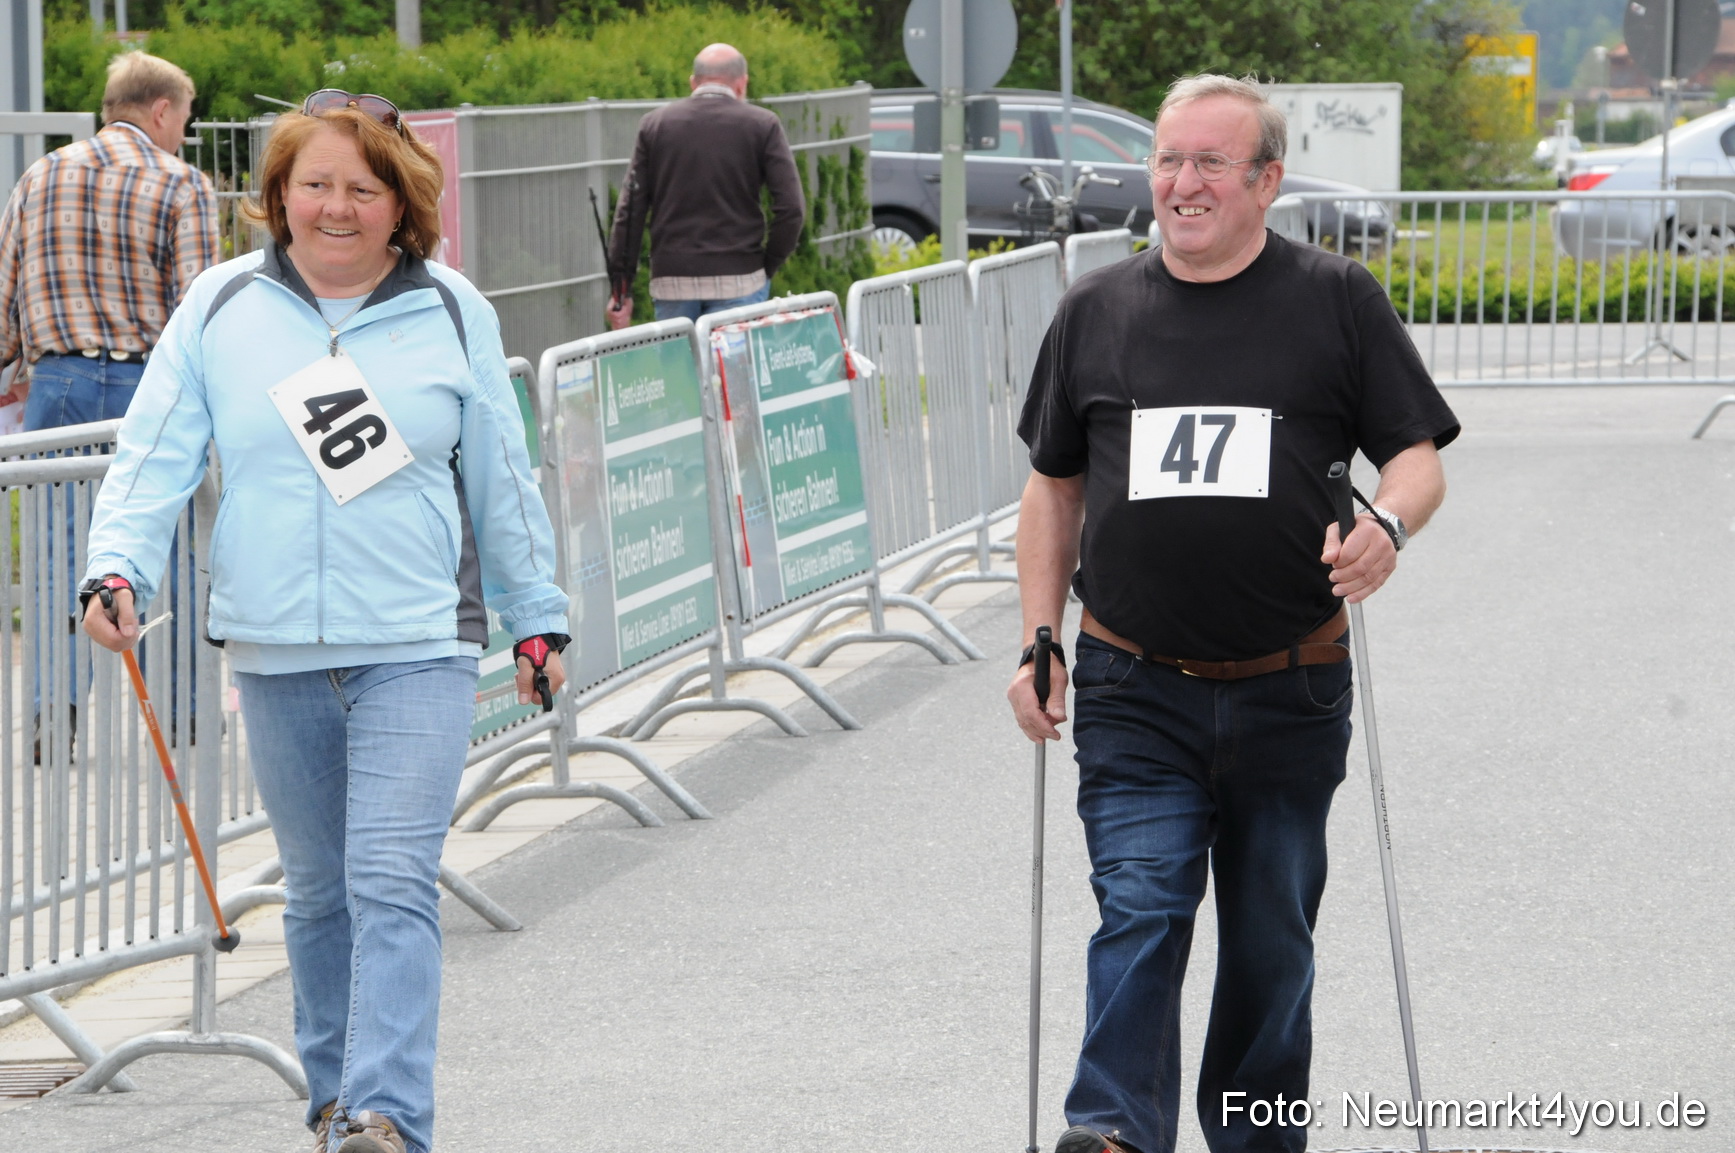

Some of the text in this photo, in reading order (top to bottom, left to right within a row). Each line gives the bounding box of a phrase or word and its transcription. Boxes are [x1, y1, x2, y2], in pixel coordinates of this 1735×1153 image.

[302, 388, 387, 470] 46
[767, 413, 827, 467] Fun & Action in
[1160, 414, 1236, 483] 47
[611, 456, 674, 517] Fun & Action in
[775, 480, 808, 523] sicheren
[616, 532, 651, 581] sicheren
